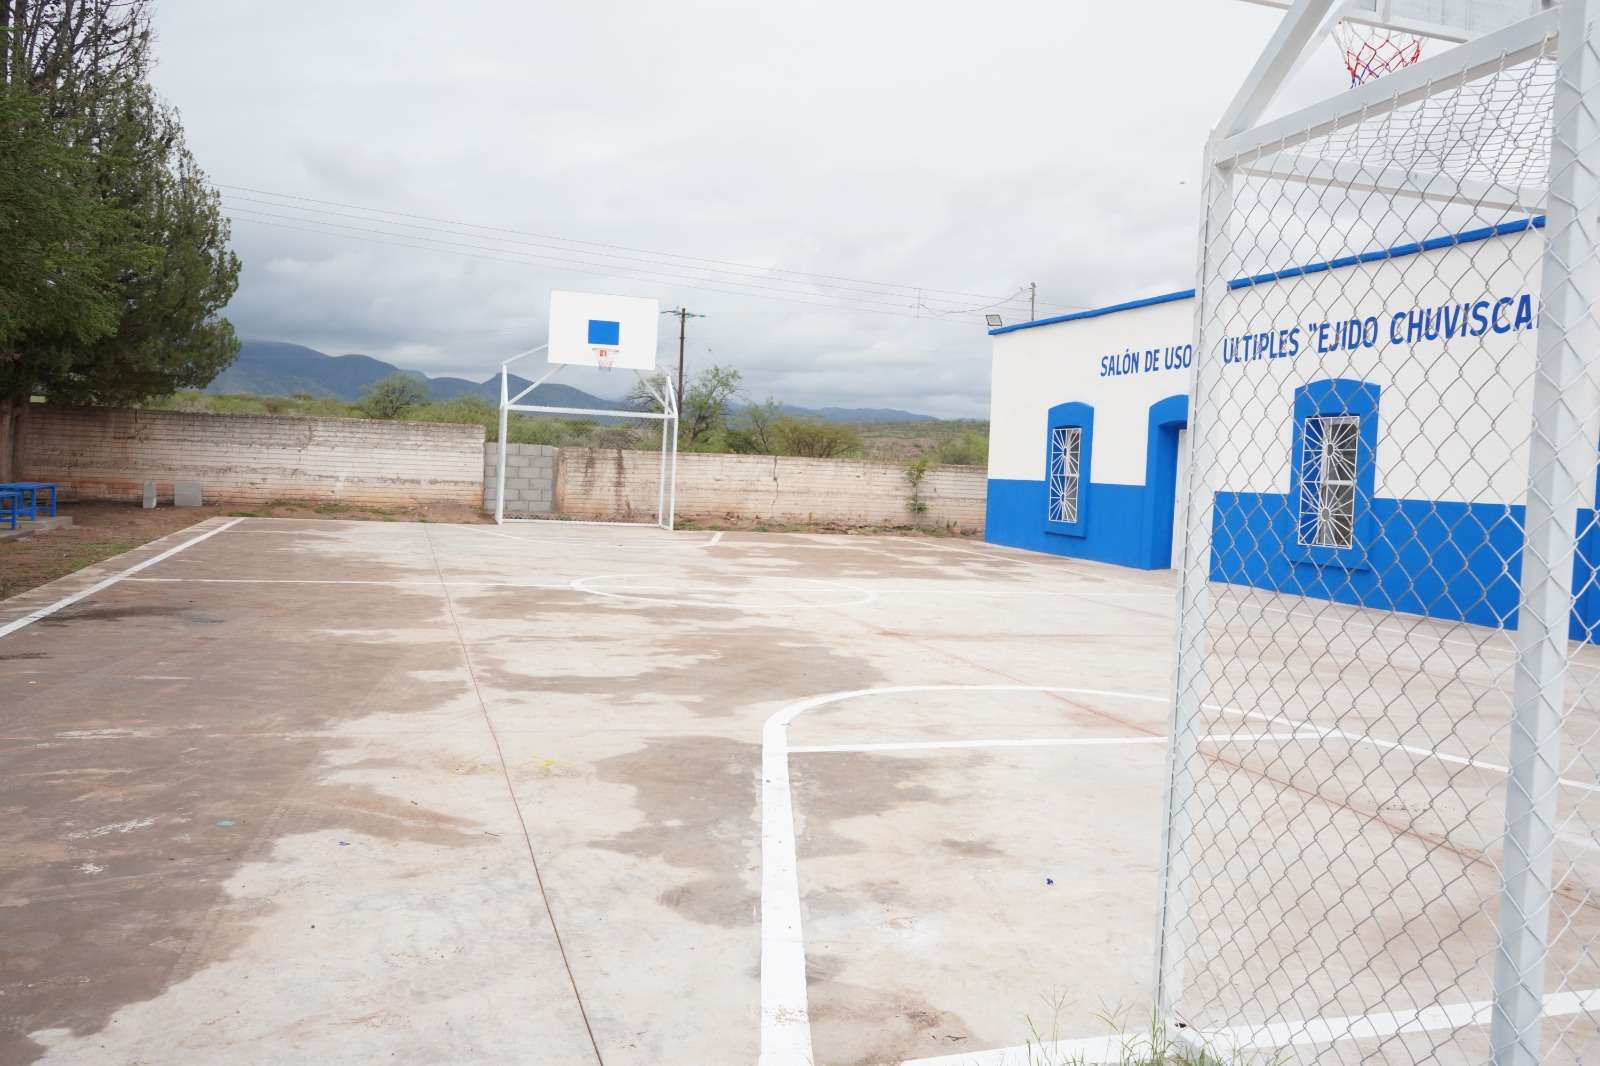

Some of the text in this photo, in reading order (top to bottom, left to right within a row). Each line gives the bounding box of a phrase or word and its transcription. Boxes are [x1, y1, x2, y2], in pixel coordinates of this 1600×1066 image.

[1100, 348, 1140, 377] SALÓN
[1144, 349, 1160, 372] DE
[1164, 344, 1193, 370] USO
[1223, 327, 1300, 364] ULTIPLES
[1389, 294, 1541, 345] CHUVISCA
